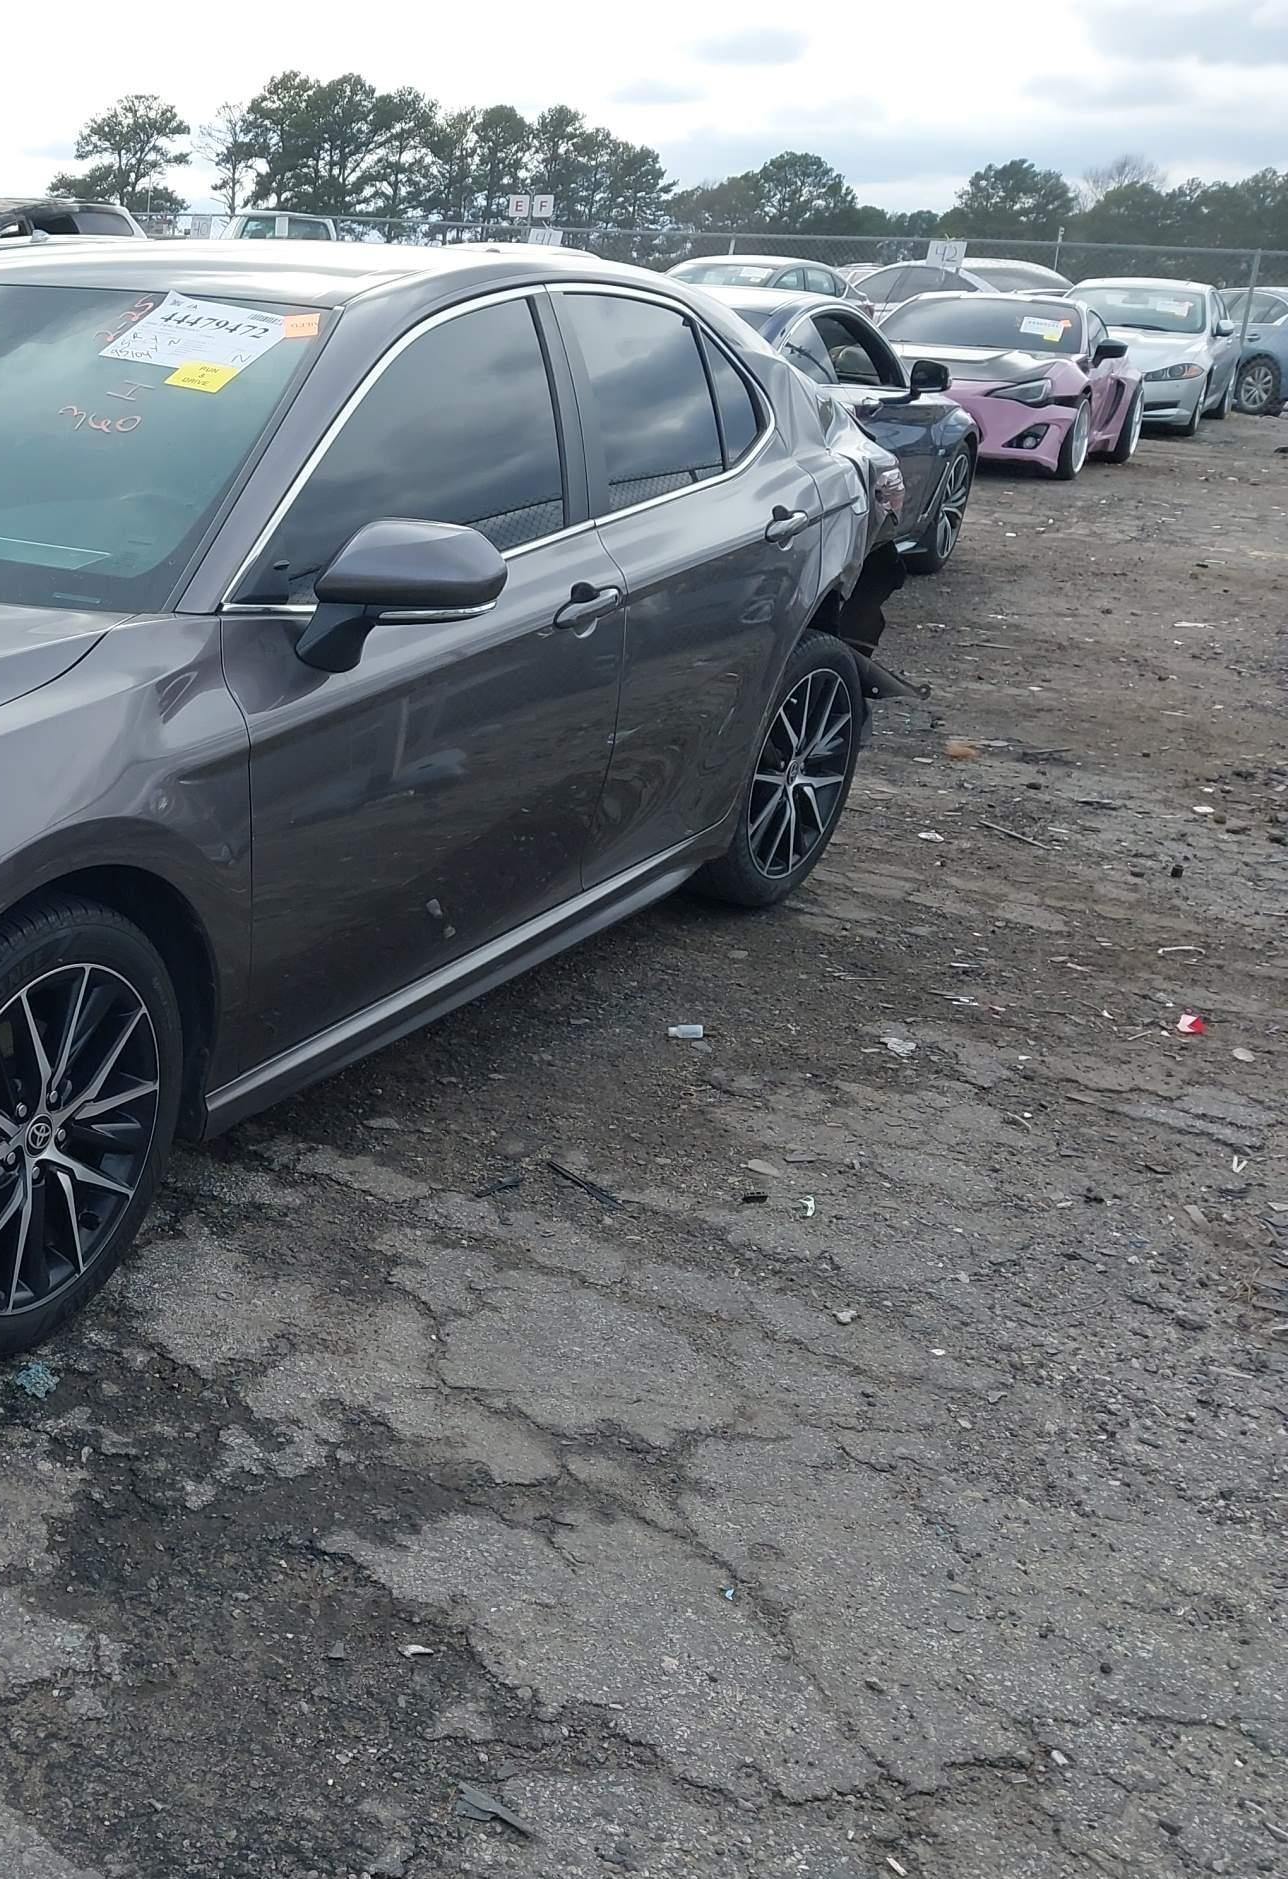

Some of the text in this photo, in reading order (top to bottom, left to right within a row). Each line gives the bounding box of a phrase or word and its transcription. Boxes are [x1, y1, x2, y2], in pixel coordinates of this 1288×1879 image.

[515, 200, 524, 212] E
[540, 200, 549, 212] F
[935, 245, 958, 263] 42
[160, 312, 269, 339] 44479472
[199, 365, 220, 374] RUN
[182, 377, 210, 387] DRIVE
